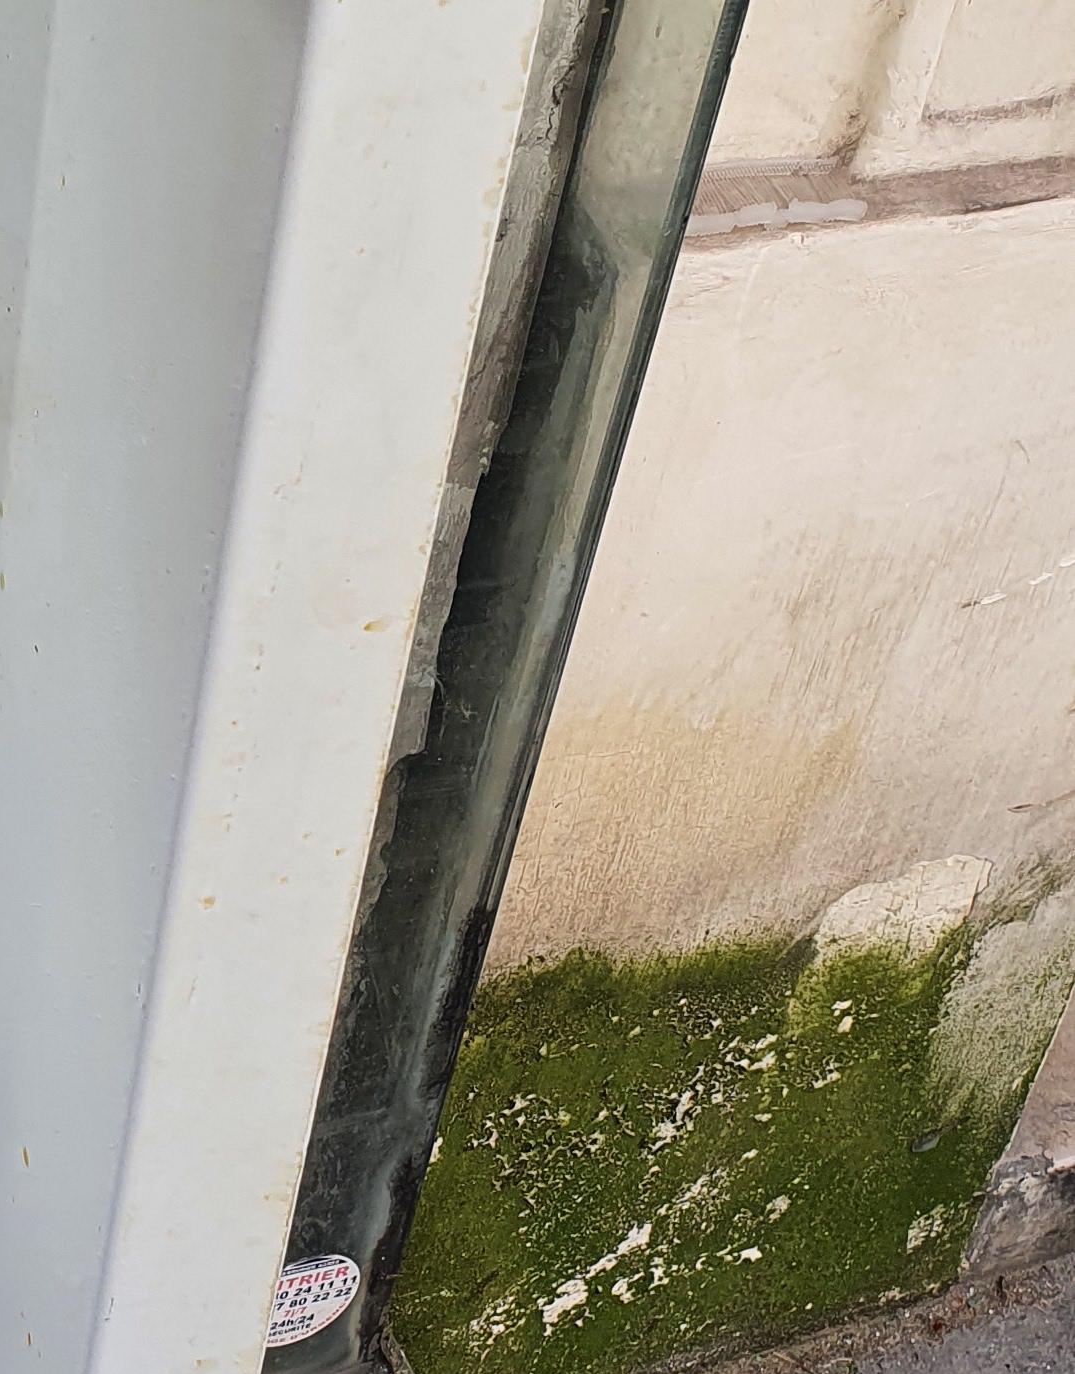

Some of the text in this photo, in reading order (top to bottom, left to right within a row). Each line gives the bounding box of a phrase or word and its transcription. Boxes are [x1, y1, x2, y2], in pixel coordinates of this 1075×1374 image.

[293, 1286, 312, 1296] 24
[317, 1281, 334, 1291] 11
[341, 1275, 357, 1286] 11
[289, 1297, 307, 1308] 80
[311, 1292, 330, 1303] 22
[333, 1287, 352, 1298] 22
[270, 1313, 314, 1330] 24h/24
